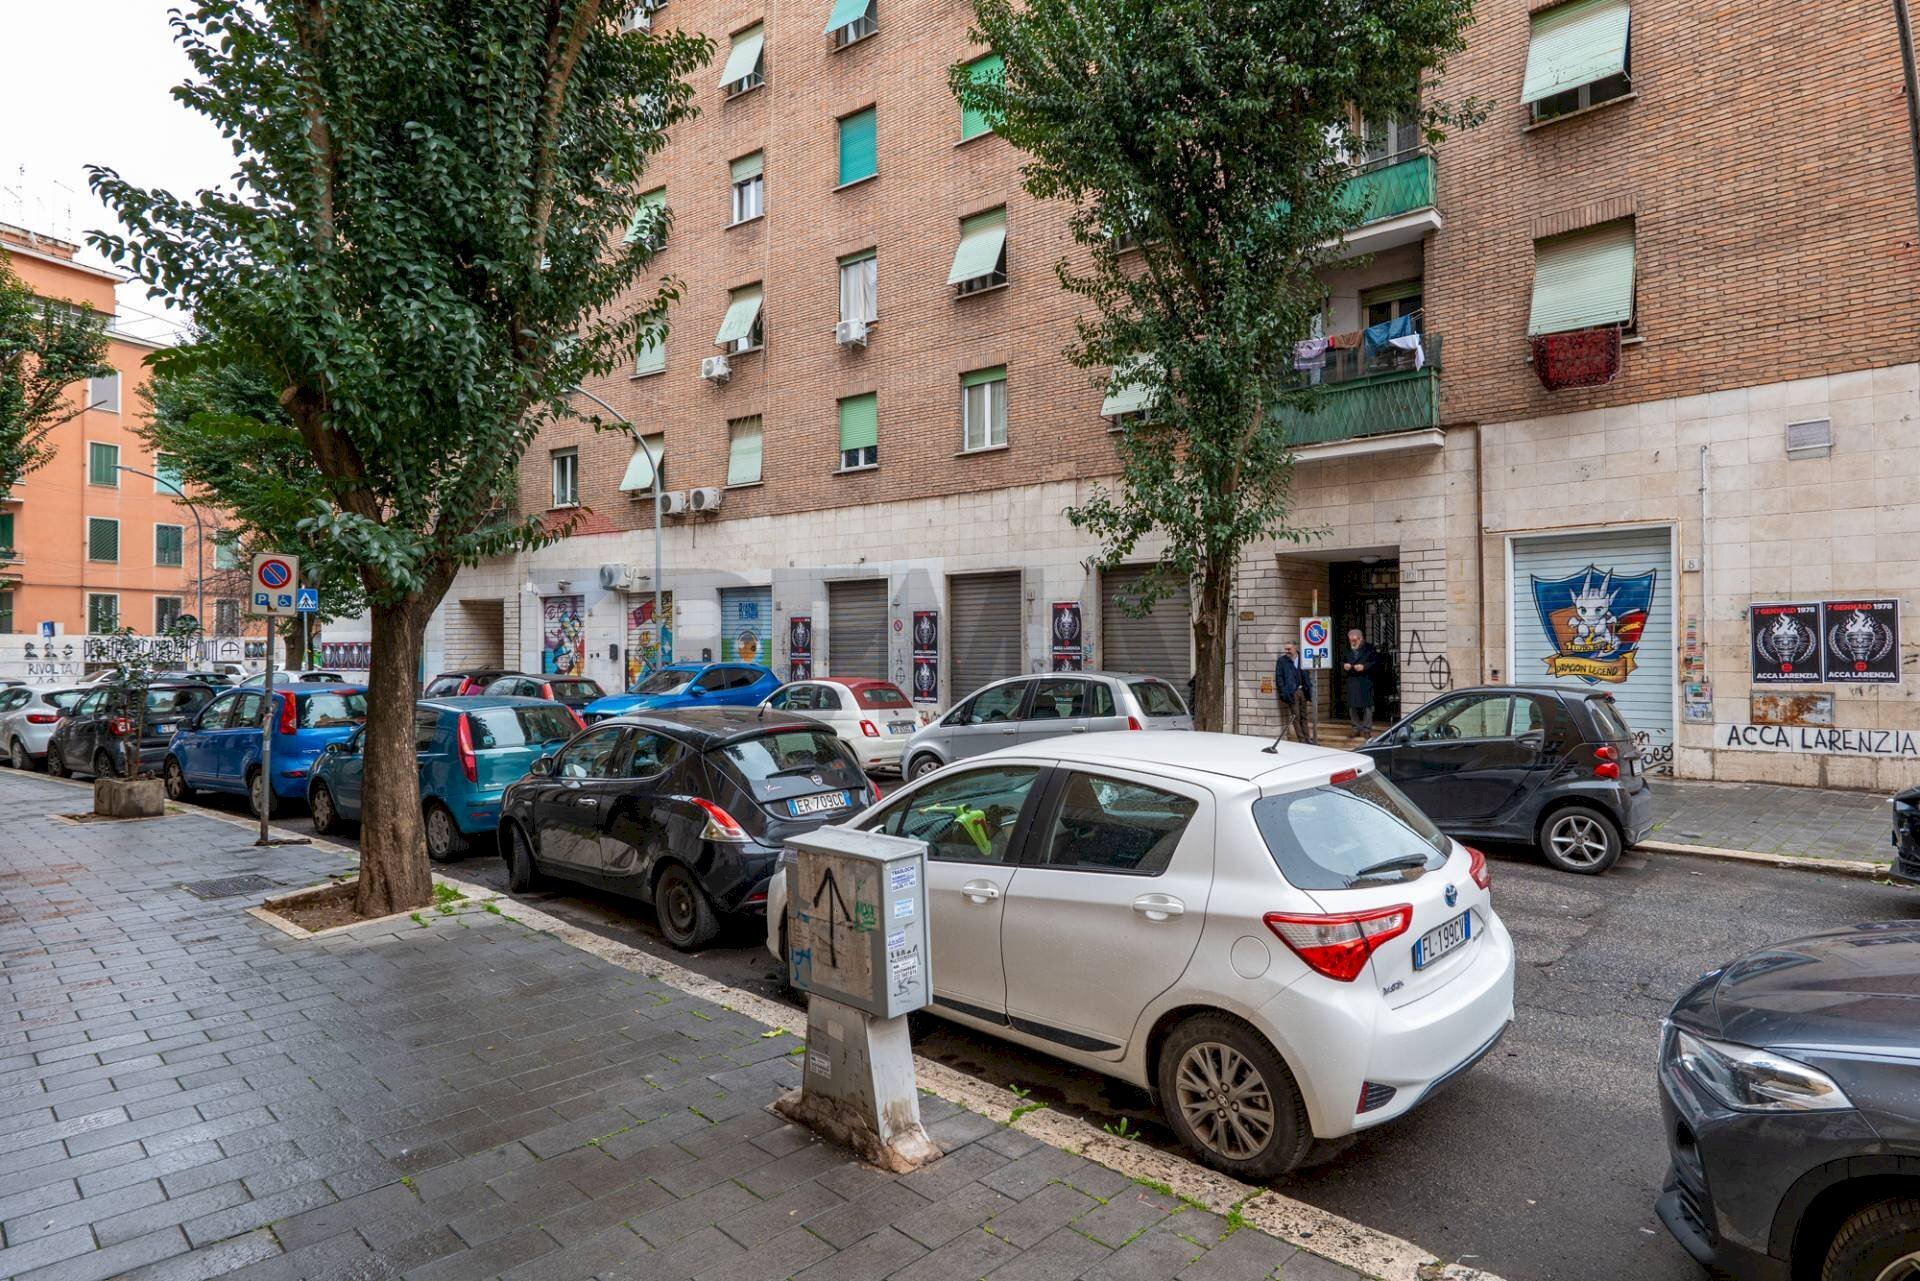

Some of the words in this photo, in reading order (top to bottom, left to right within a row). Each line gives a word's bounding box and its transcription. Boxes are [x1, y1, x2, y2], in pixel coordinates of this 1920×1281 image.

[1687, 559, 1695, 569] 8
[257, 594, 267, 604] P
[1797, 606, 1816, 614] 1978
[1873, 602, 1893, 610] 1978
[1556, 663, 1587, 673] DRAGON
[1588, 664, 1618, 676] LEGEND
[1852, 671, 1896, 679] LARENZIA
[1727, 725, 1790, 748] ACCA
[1801, 728, 1917, 755] LARENZIA
[797, 797, 812, 813] ER
[814, 793, 845, 811] 709CC
[1422, 936, 1435, 961] FL
[1438, 916, 1464, 953] 199CV
